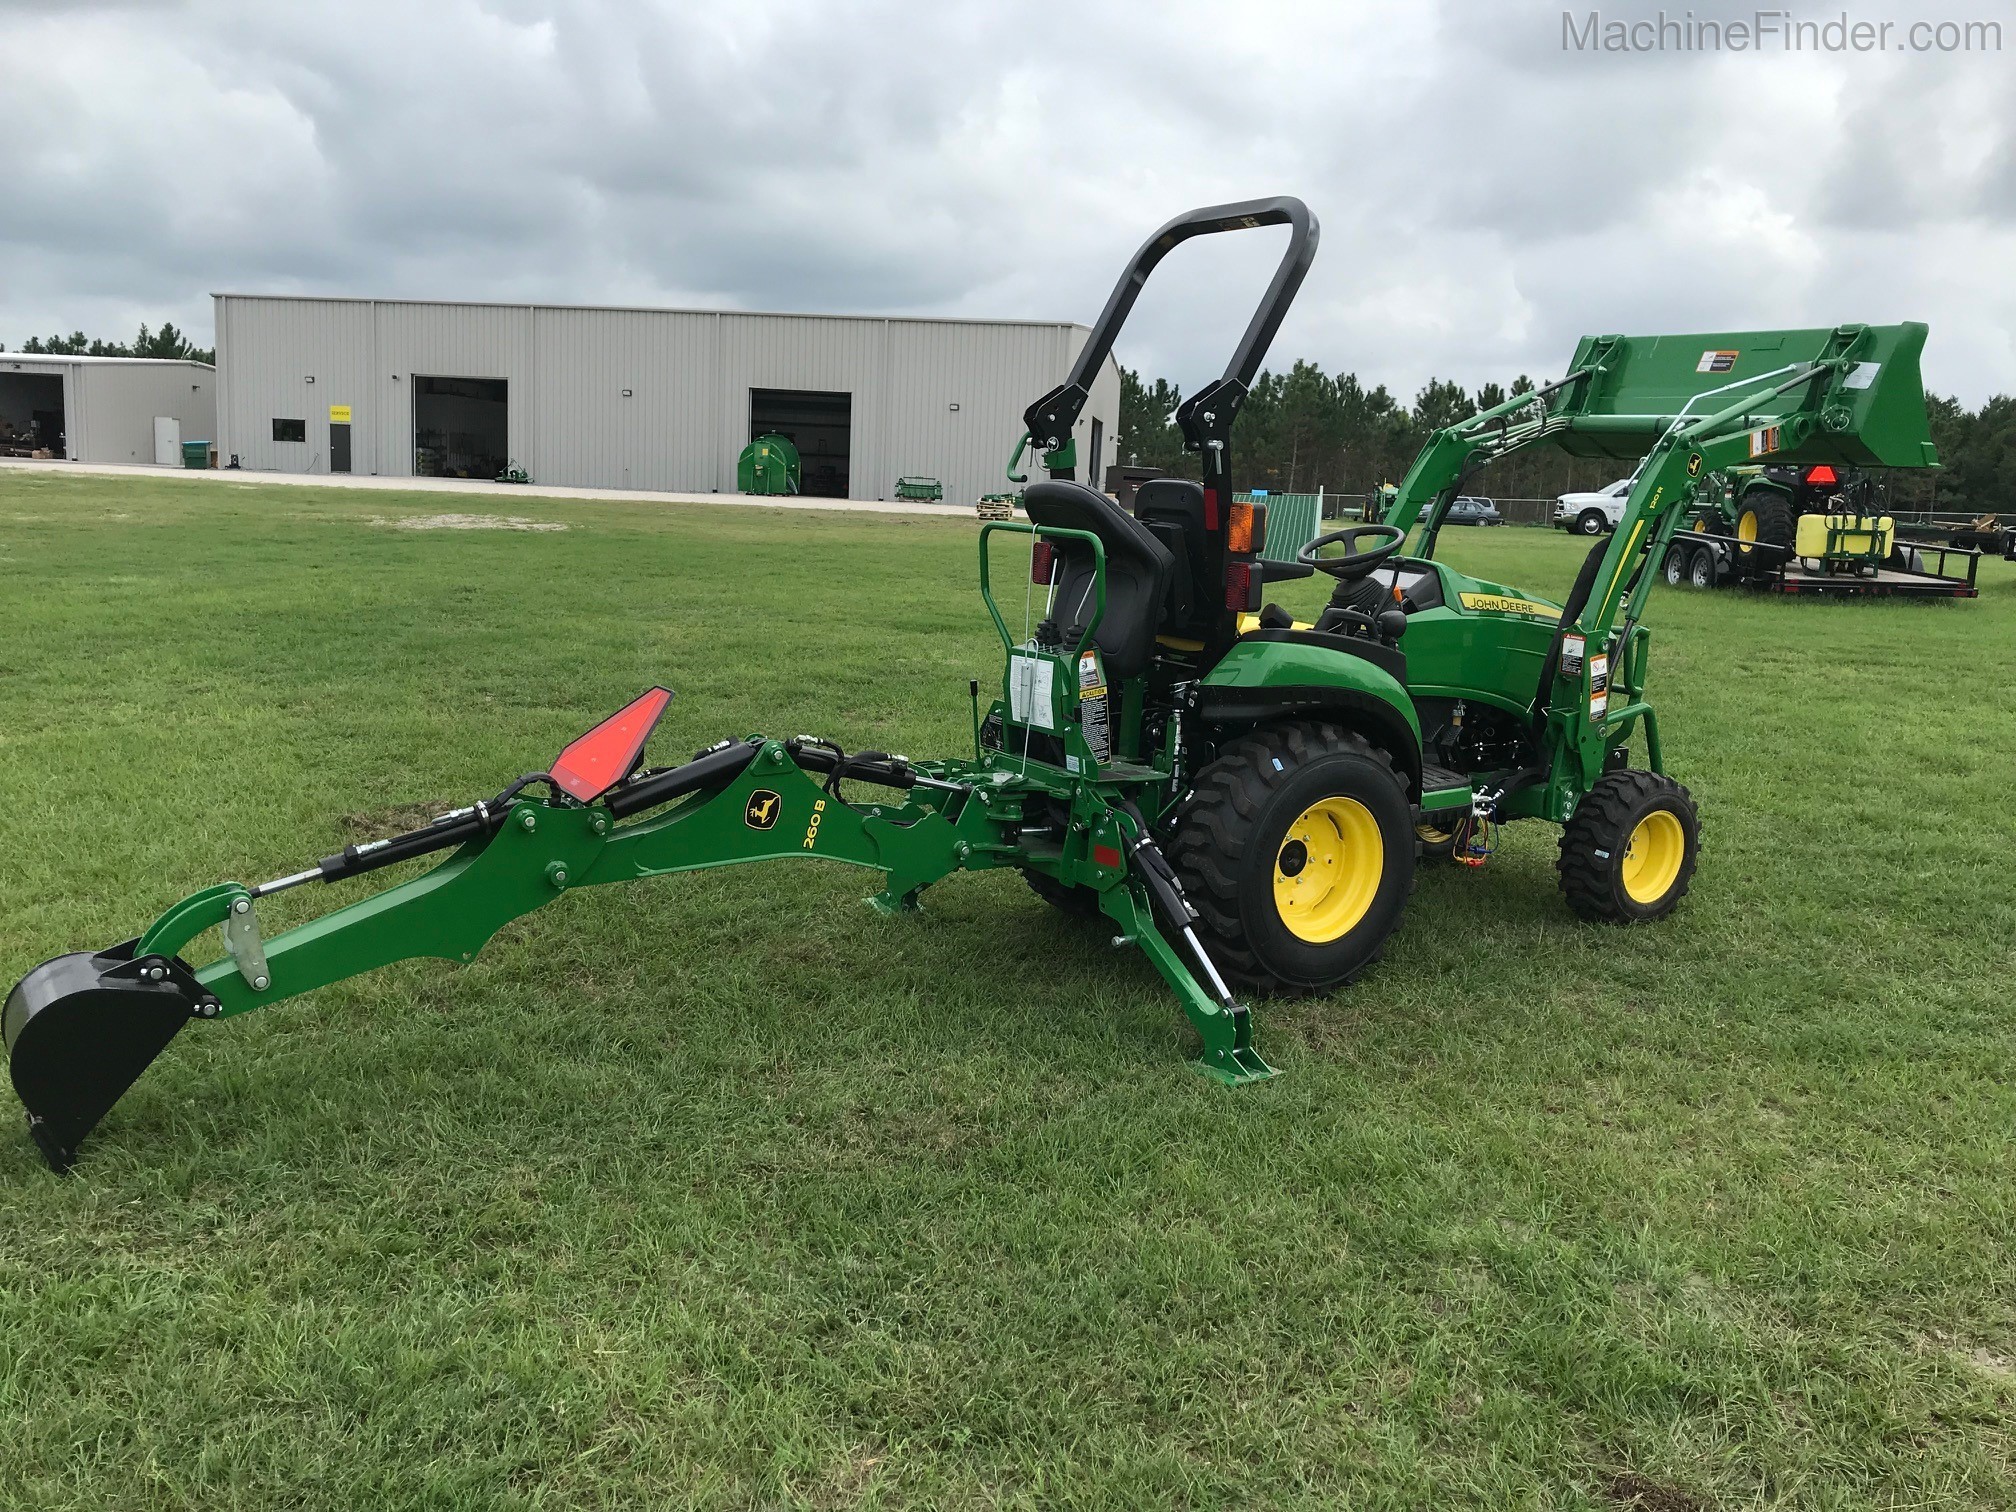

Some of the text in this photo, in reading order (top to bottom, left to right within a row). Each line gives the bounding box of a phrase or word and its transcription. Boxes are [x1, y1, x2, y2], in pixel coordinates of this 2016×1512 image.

[1470, 597, 1535, 614] JOHN DEERE
[1086, 688, 1105, 698] CAUTION
[803, 799, 826, 849] 260B
